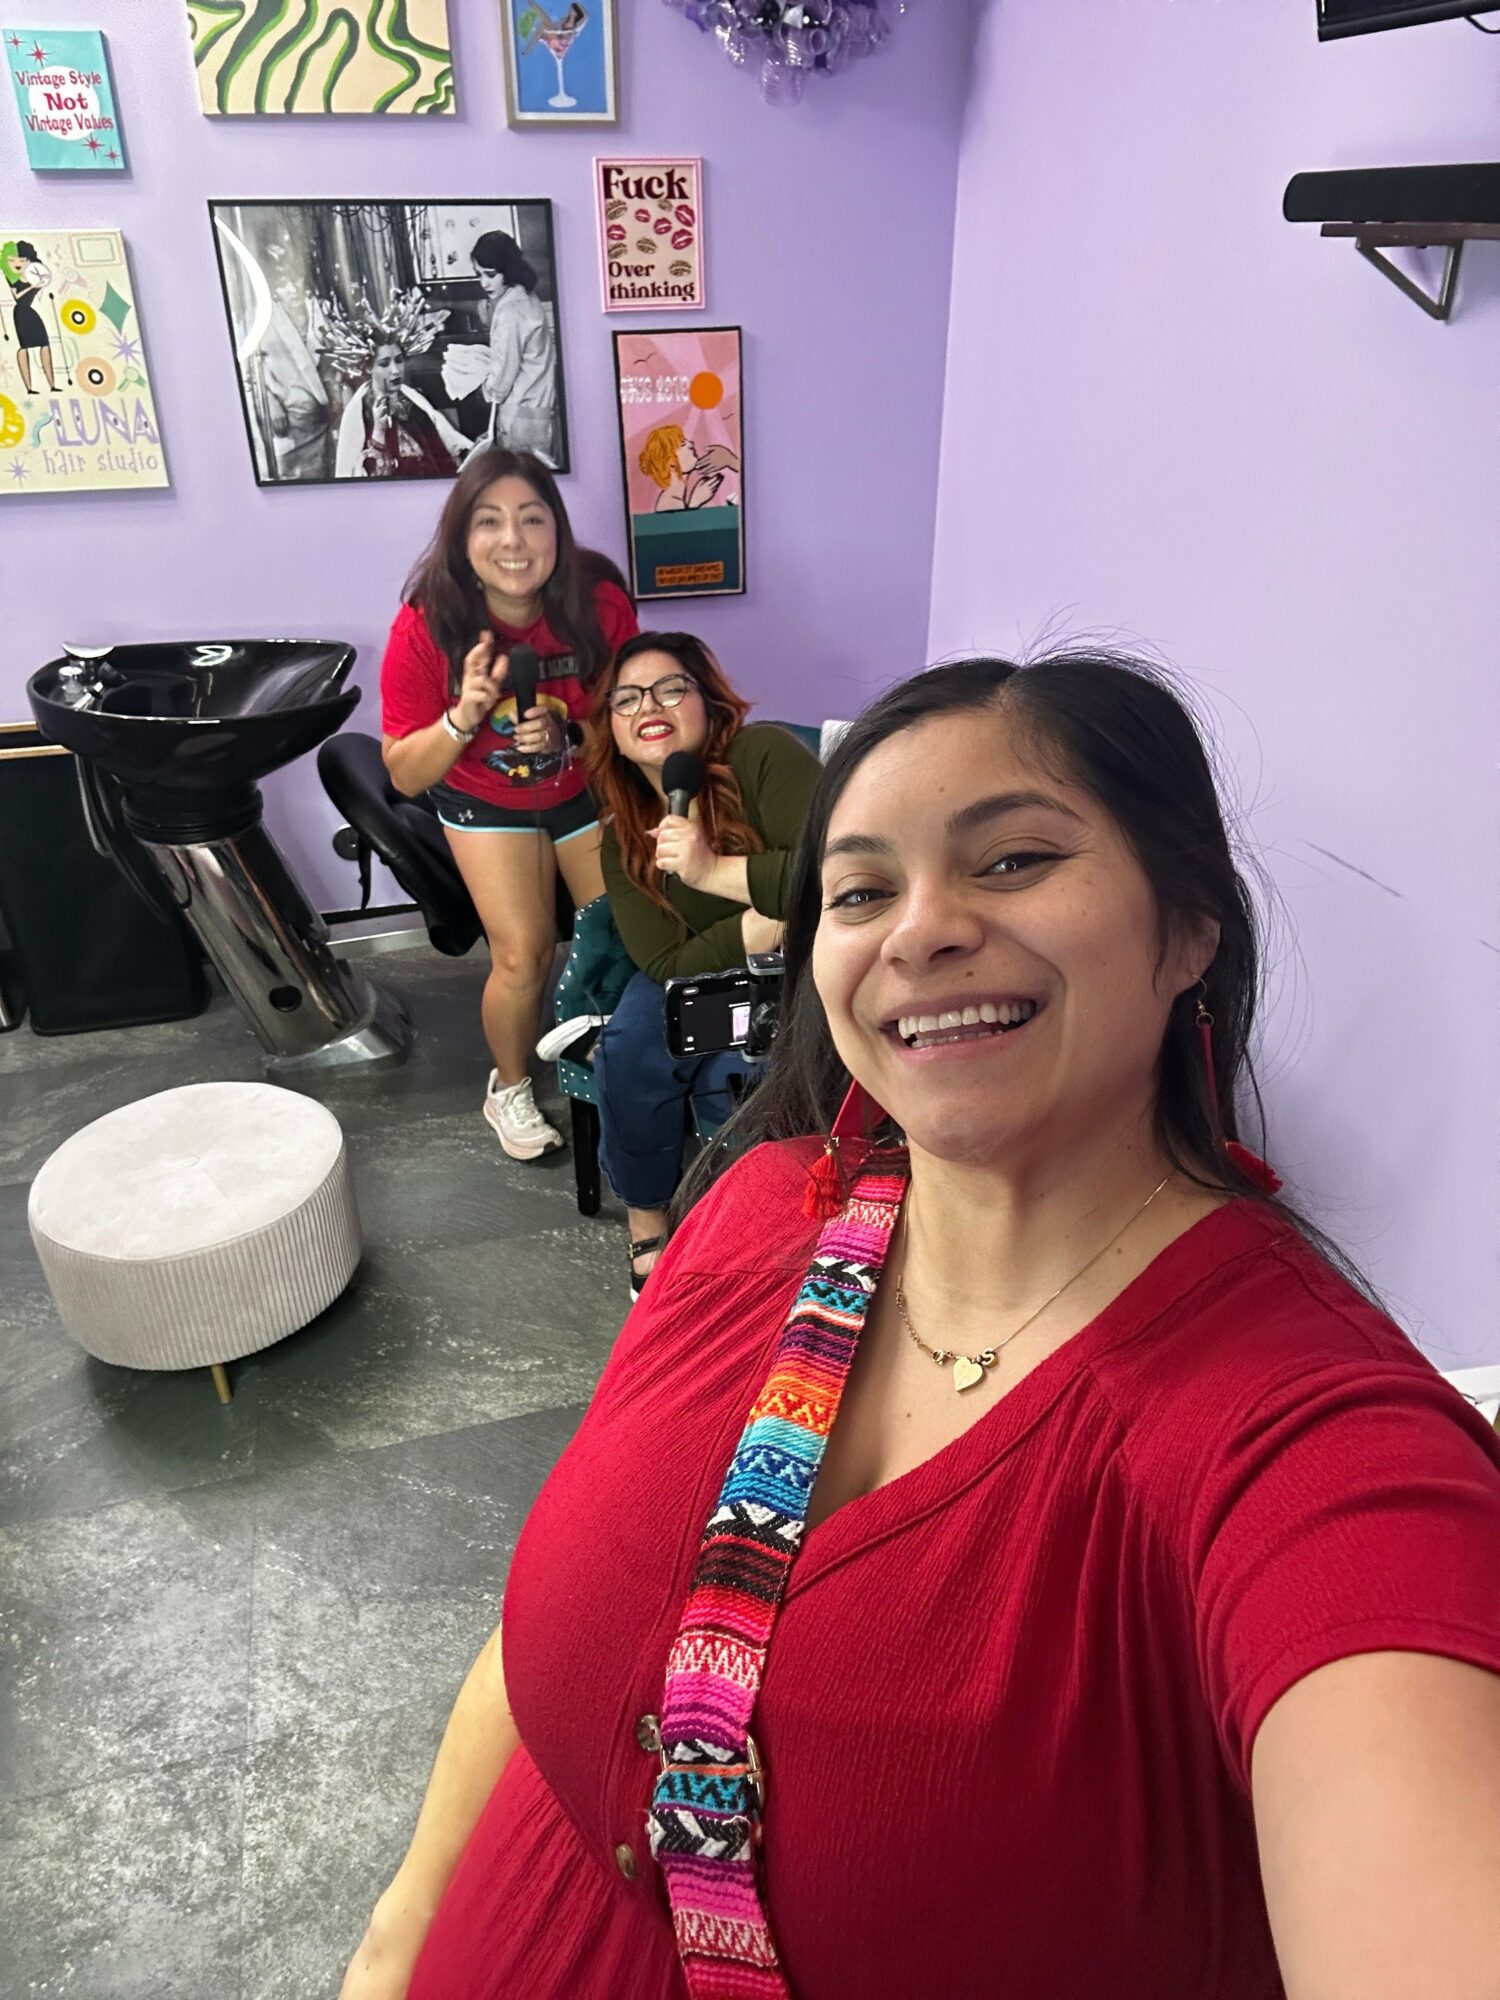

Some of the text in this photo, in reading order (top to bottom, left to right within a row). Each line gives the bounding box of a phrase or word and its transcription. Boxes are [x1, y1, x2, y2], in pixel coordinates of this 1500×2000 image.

[15, 70, 102, 89] Vintage Style
[43, 92, 89, 111] Not
[25, 110, 114, 135] Vintage Values
[602, 167, 690, 200] Fuck
[608, 261, 655, 278] Over
[610, 281, 695, 302] thinking
[48, 398, 160, 447] LUNA
[42, 447, 158, 475] hair studio
